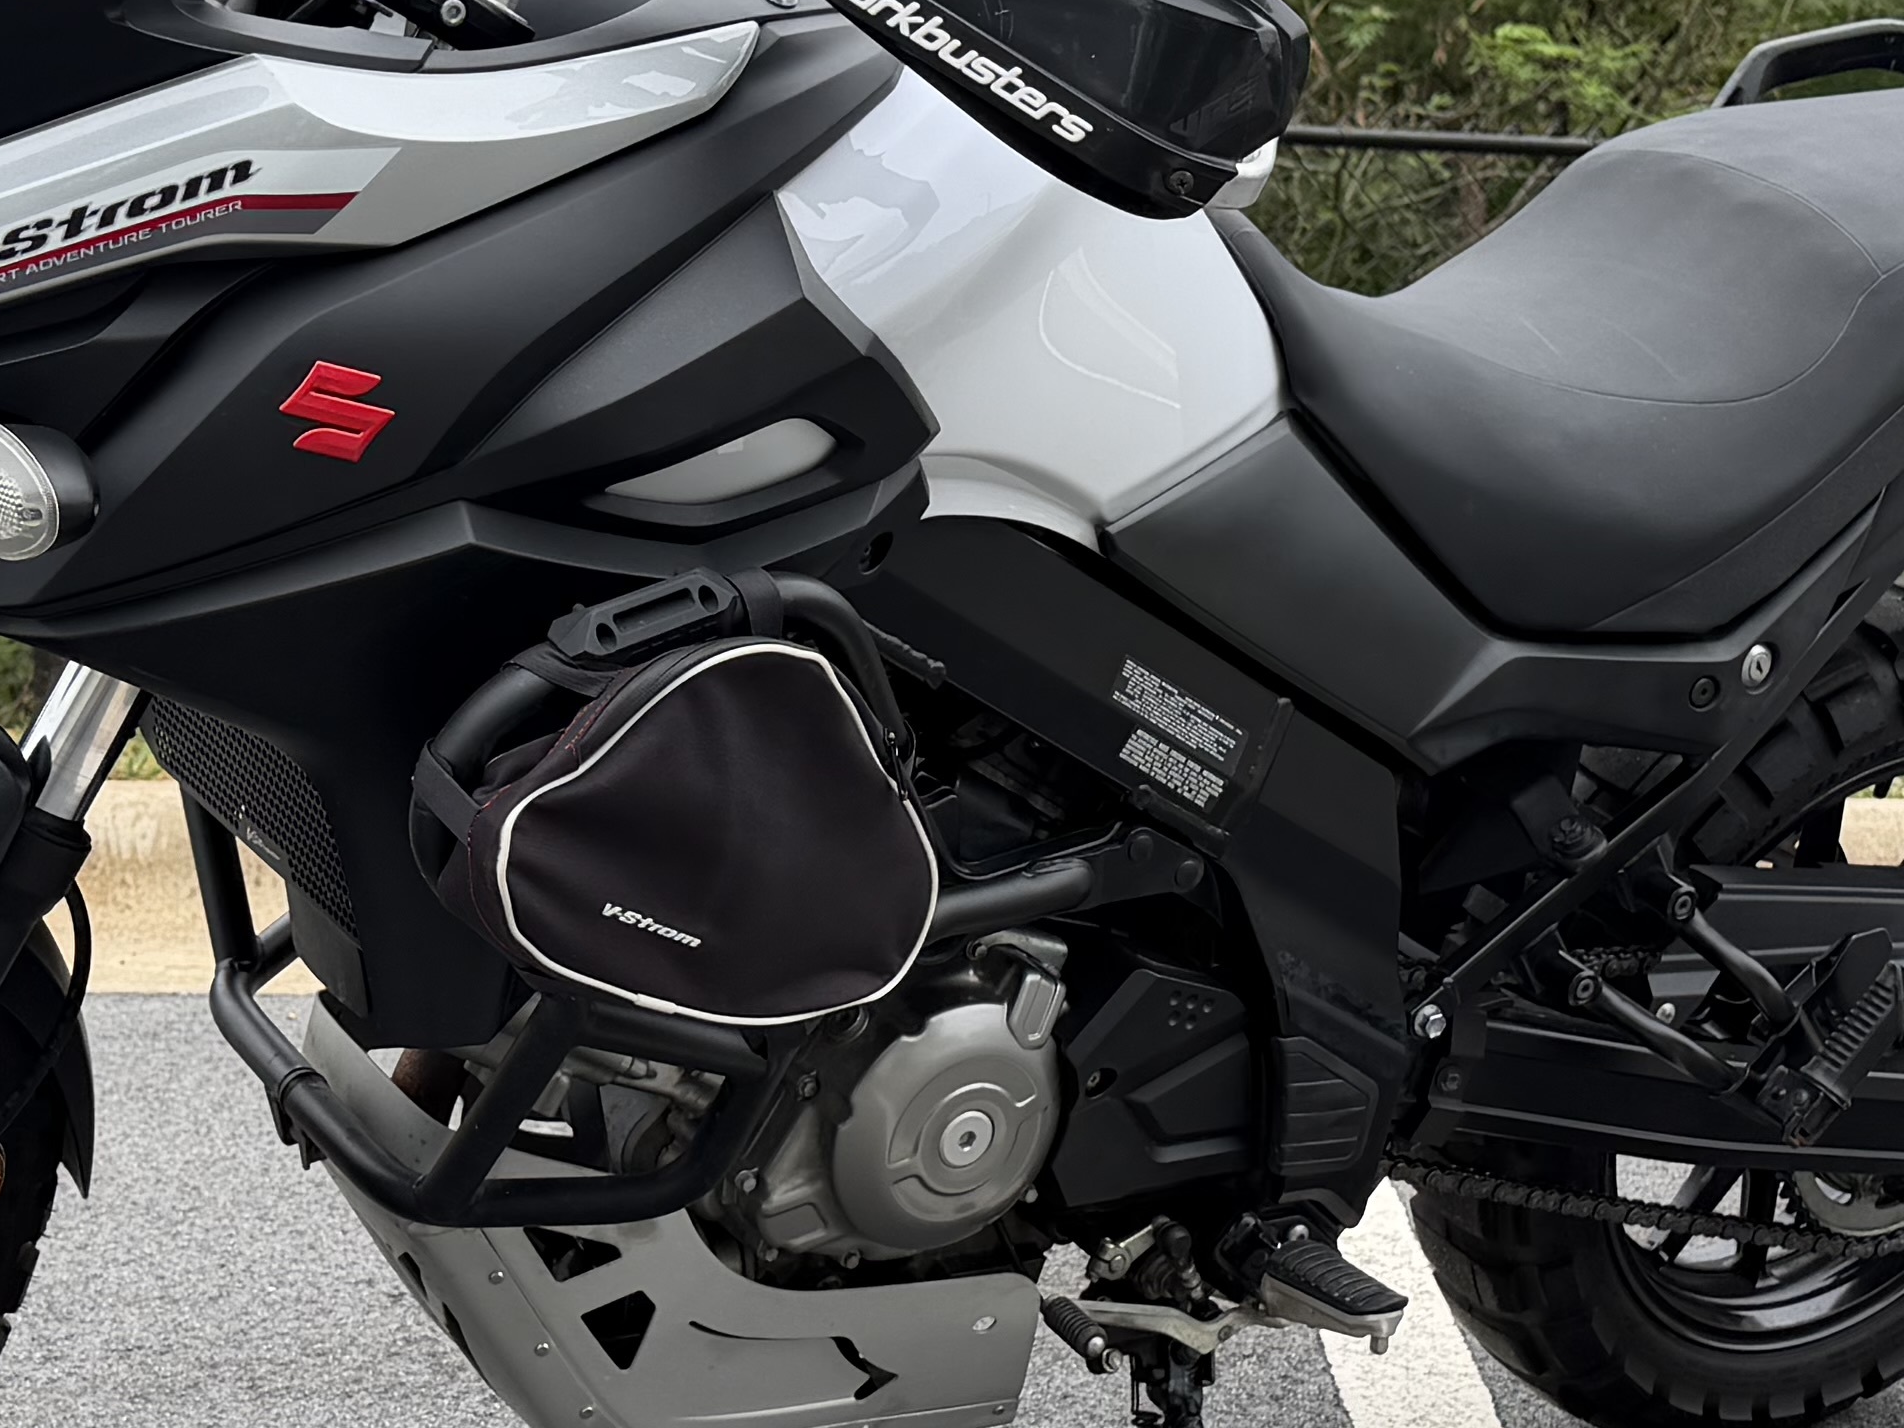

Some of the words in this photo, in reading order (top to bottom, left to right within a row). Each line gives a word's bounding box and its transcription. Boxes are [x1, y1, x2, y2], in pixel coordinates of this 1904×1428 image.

[26, 227, 152, 275] ADVENTURE
[157, 200, 243, 236] TOURER
[600, 902, 702, 949] V-Strom
